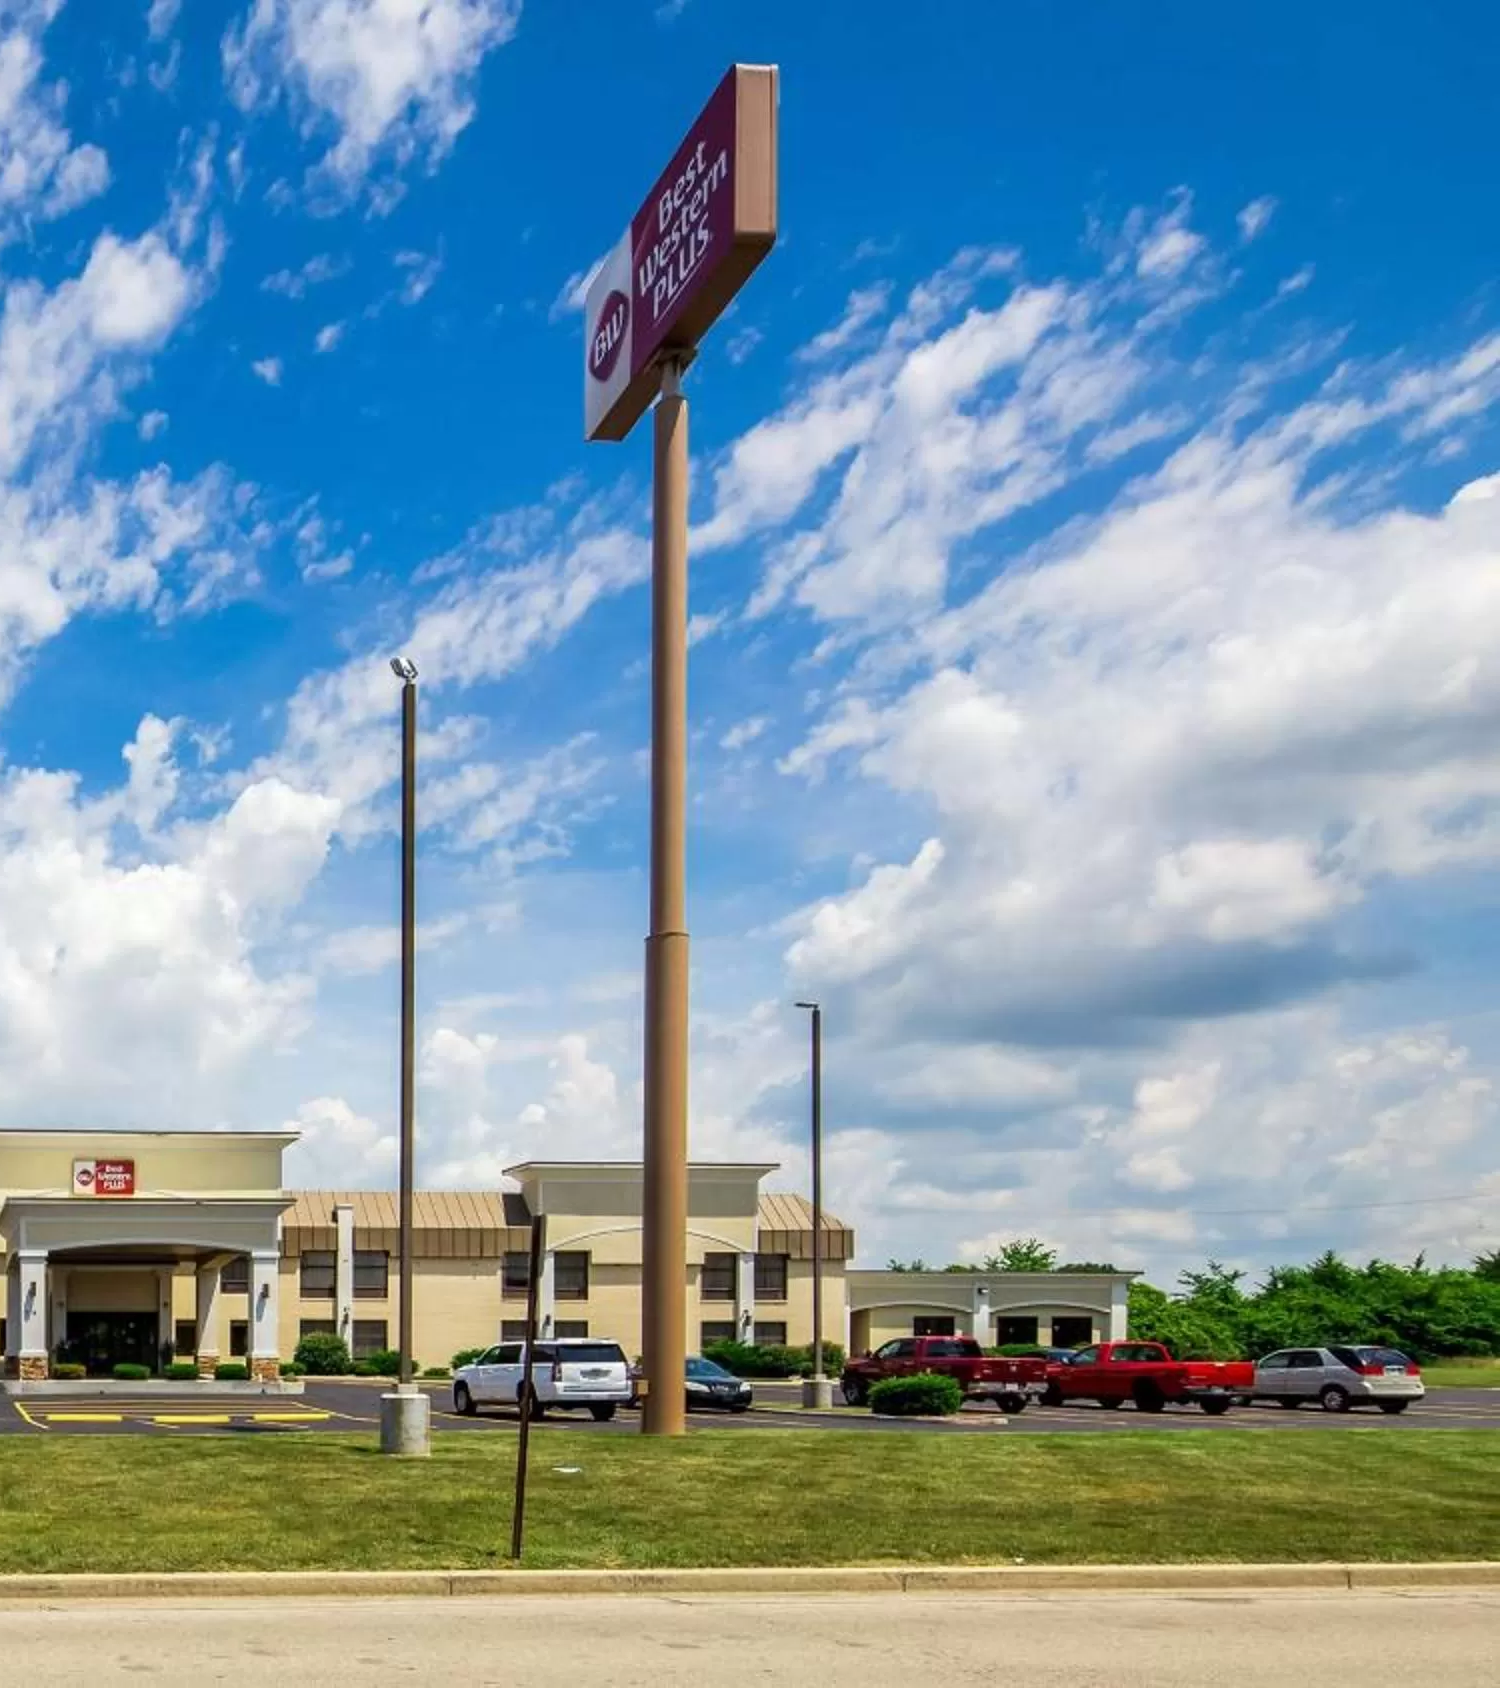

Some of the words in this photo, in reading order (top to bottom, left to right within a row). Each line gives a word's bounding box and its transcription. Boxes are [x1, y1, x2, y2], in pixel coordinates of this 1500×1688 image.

[638, 149, 728, 297] Western
[658, 140, 706, 234] Best
[653, 213, 710, 319] PLUS
[594, 303, 625, 368] BW
